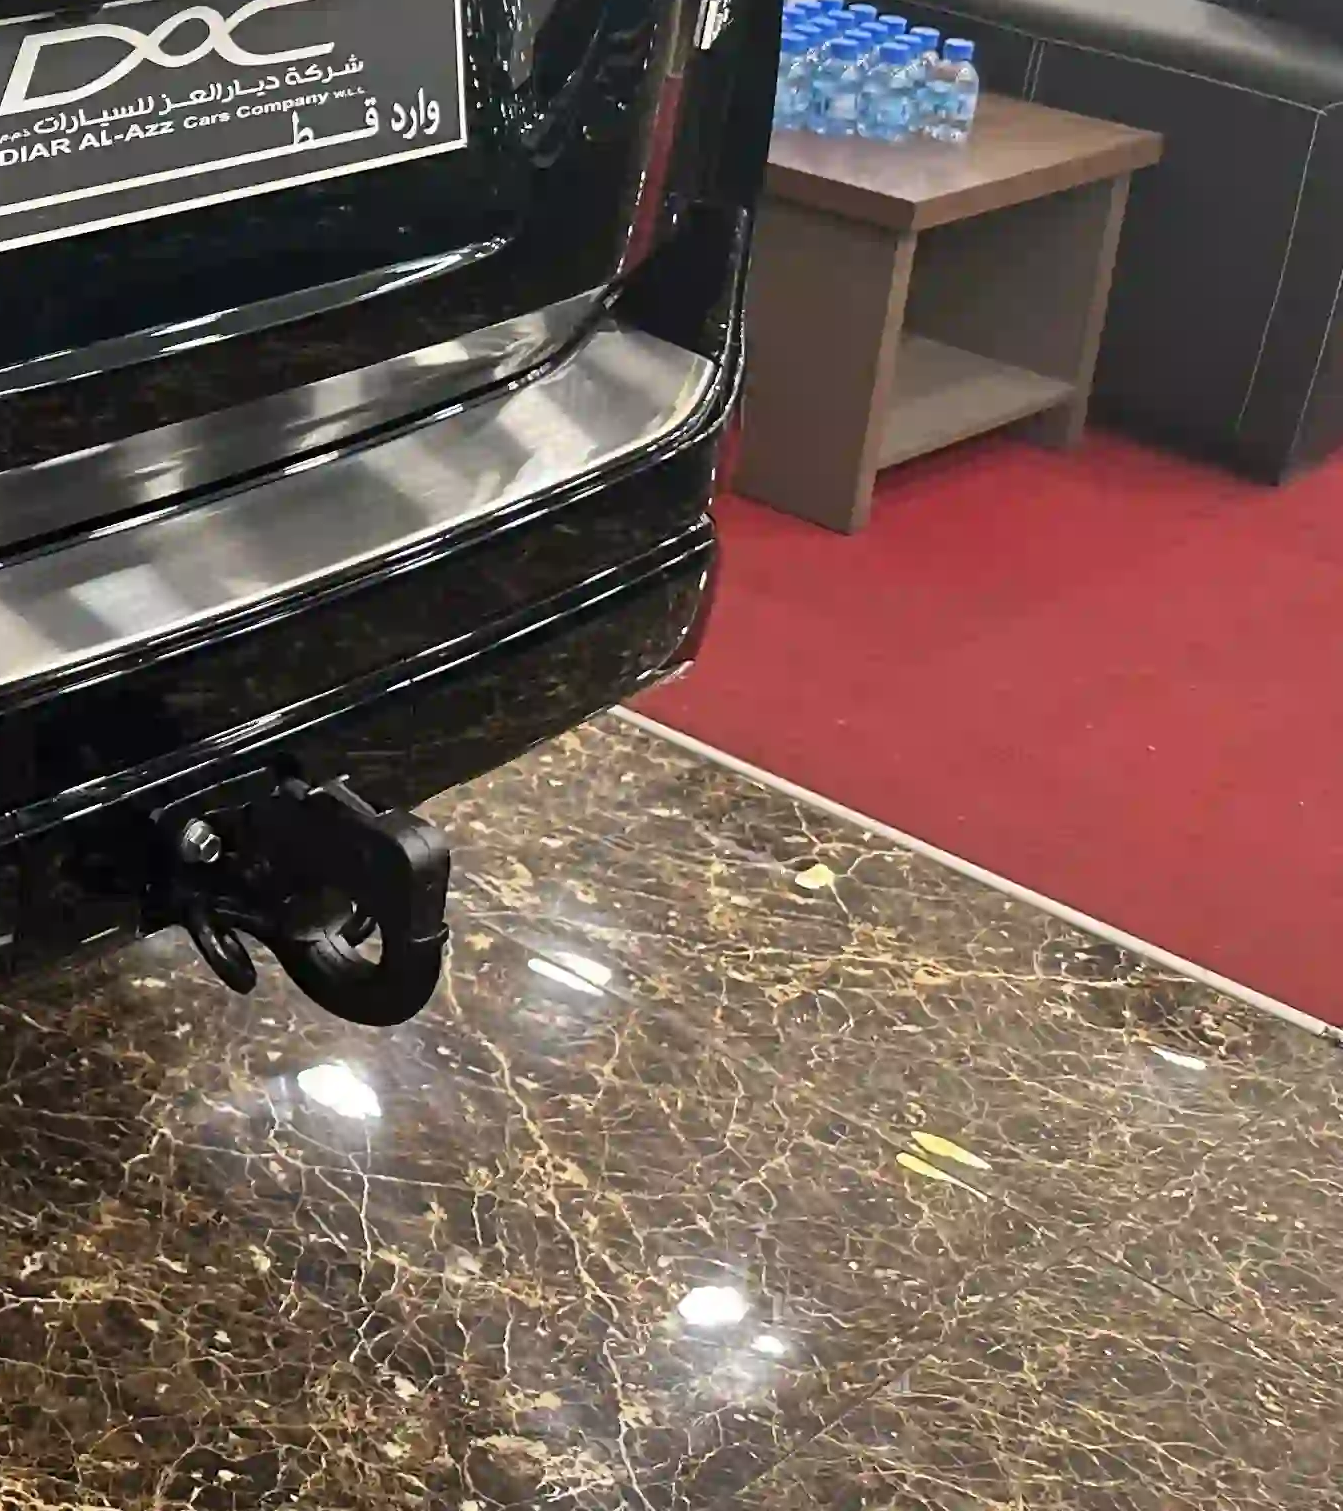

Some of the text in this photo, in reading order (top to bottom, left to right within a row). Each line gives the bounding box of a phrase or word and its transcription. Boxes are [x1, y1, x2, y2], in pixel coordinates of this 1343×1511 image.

[283, 53, 365, 84] شركة
[33, 95, 156, 135] للسيارات
[183, 110, 232, 130] Cars
[236, 91, 329, 119] Company
[390, 87, 441, 140] وارد
